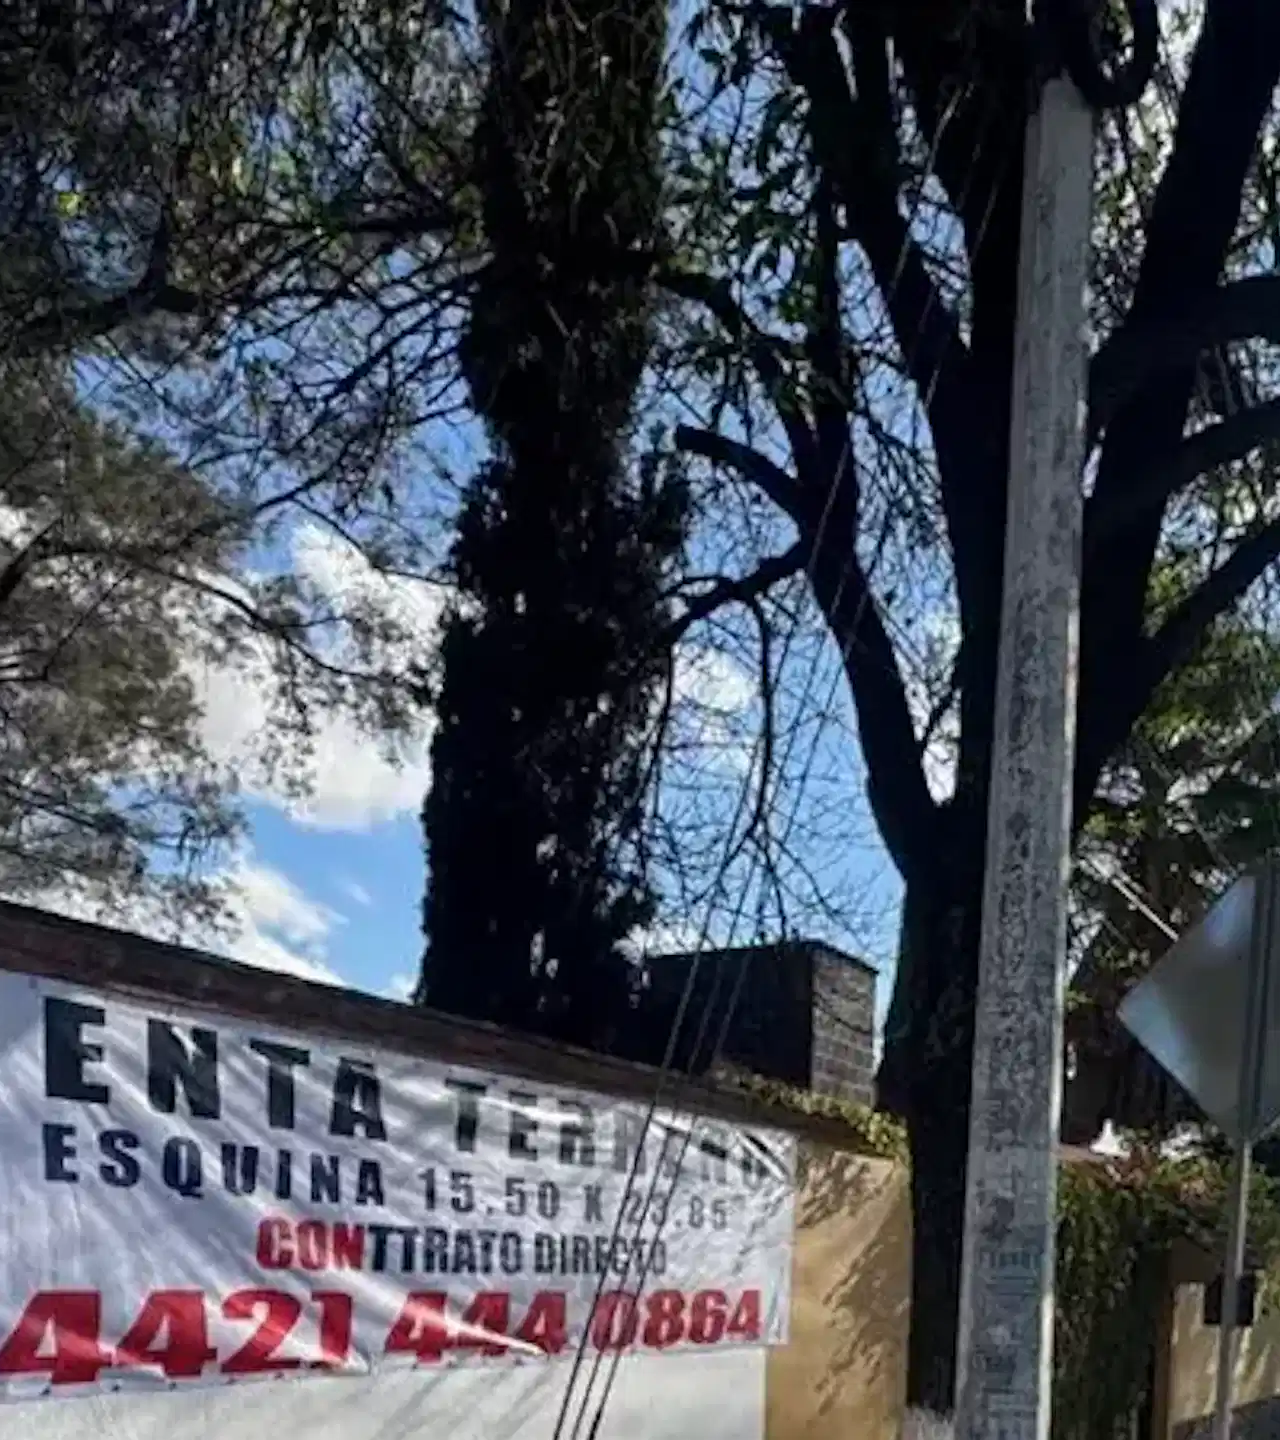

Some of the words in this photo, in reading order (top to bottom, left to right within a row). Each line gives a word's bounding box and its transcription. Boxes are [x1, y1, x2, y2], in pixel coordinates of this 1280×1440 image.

[41, 1122, 385, 1206] ESQUINA
[418, 1167, 560, 1221] 15.50
[255, 1216, 521, 1276] CONTTRATO
[533, 1231, 667, 1277] DIRECTO
[383, 1290, 569, 1363] 444
[588, 1289, 763, 1353] 0864
